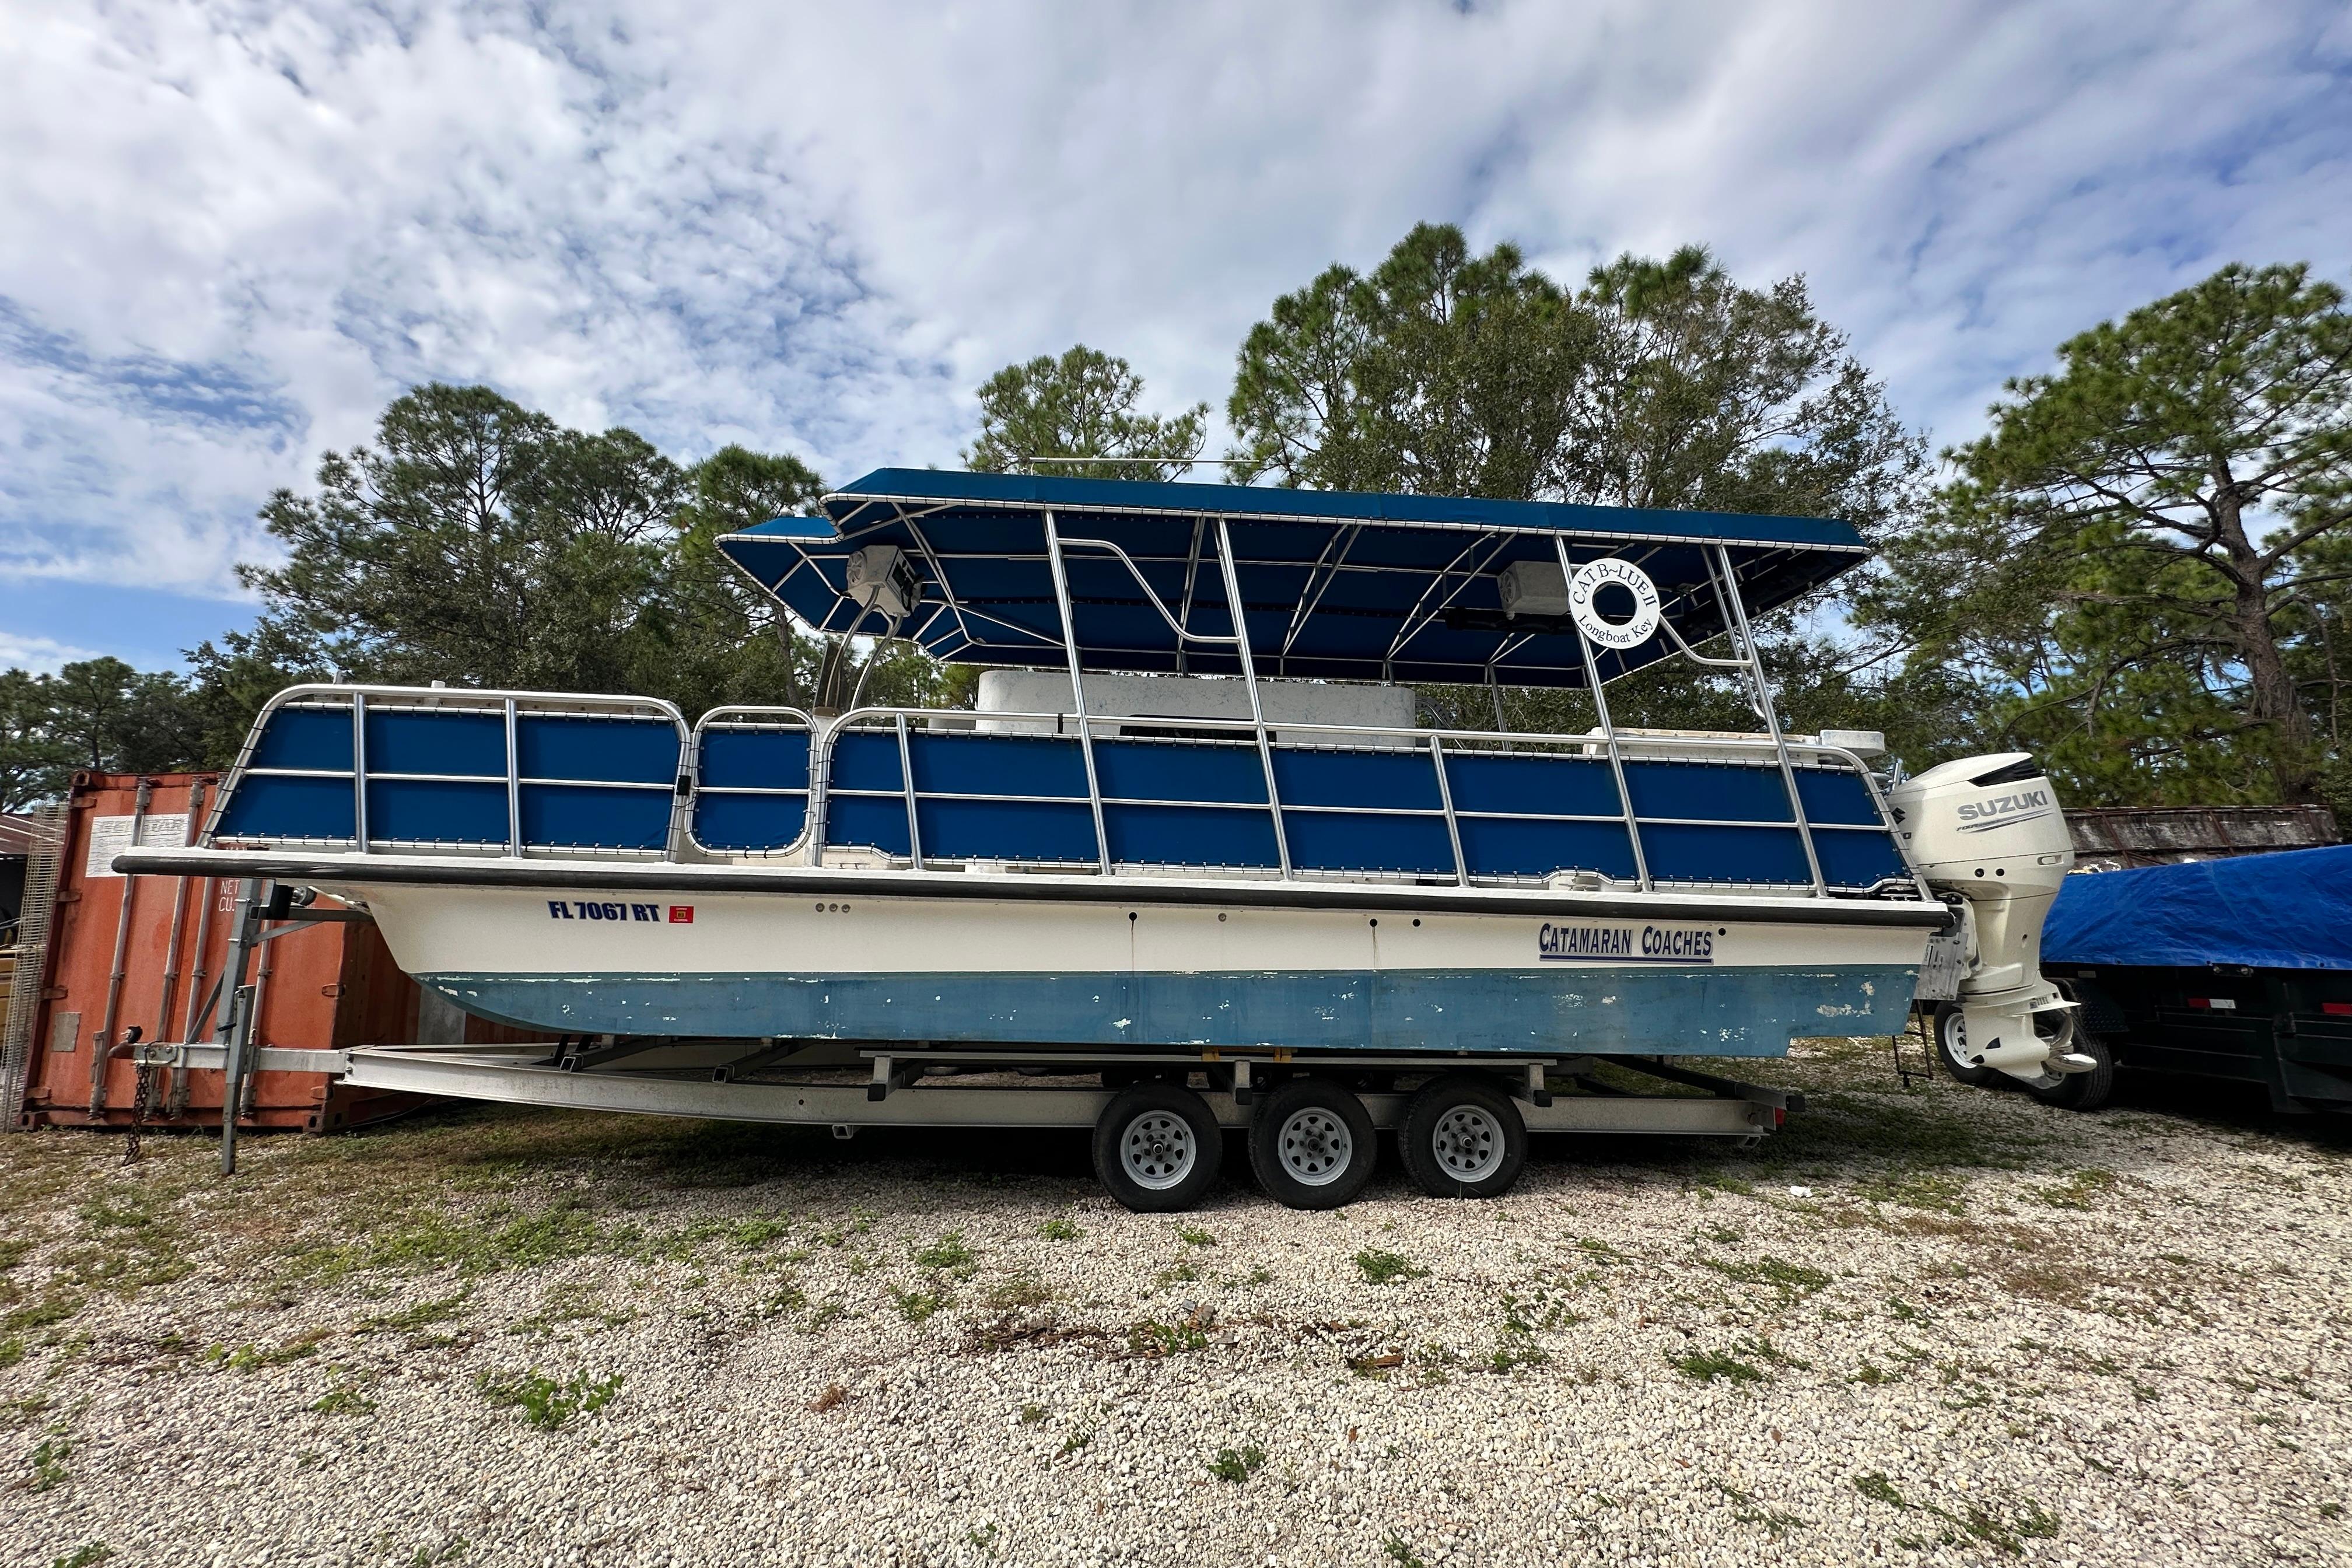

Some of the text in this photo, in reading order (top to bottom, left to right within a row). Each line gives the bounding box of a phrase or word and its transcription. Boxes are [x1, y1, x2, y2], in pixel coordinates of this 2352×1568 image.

[1573, 569, 1597, 605] CAT
[1642, 594, 1657, 607] II
[1578, 615, 1653, 643] Longboat Key
[1958, 790, 2048, 820] SUZUKI
[220, 880, 240, 895] NET
[547, 901, 661, 922] FL 7067 RT
[1539, 923, 1713, 956] CATAMARAN COACHES
